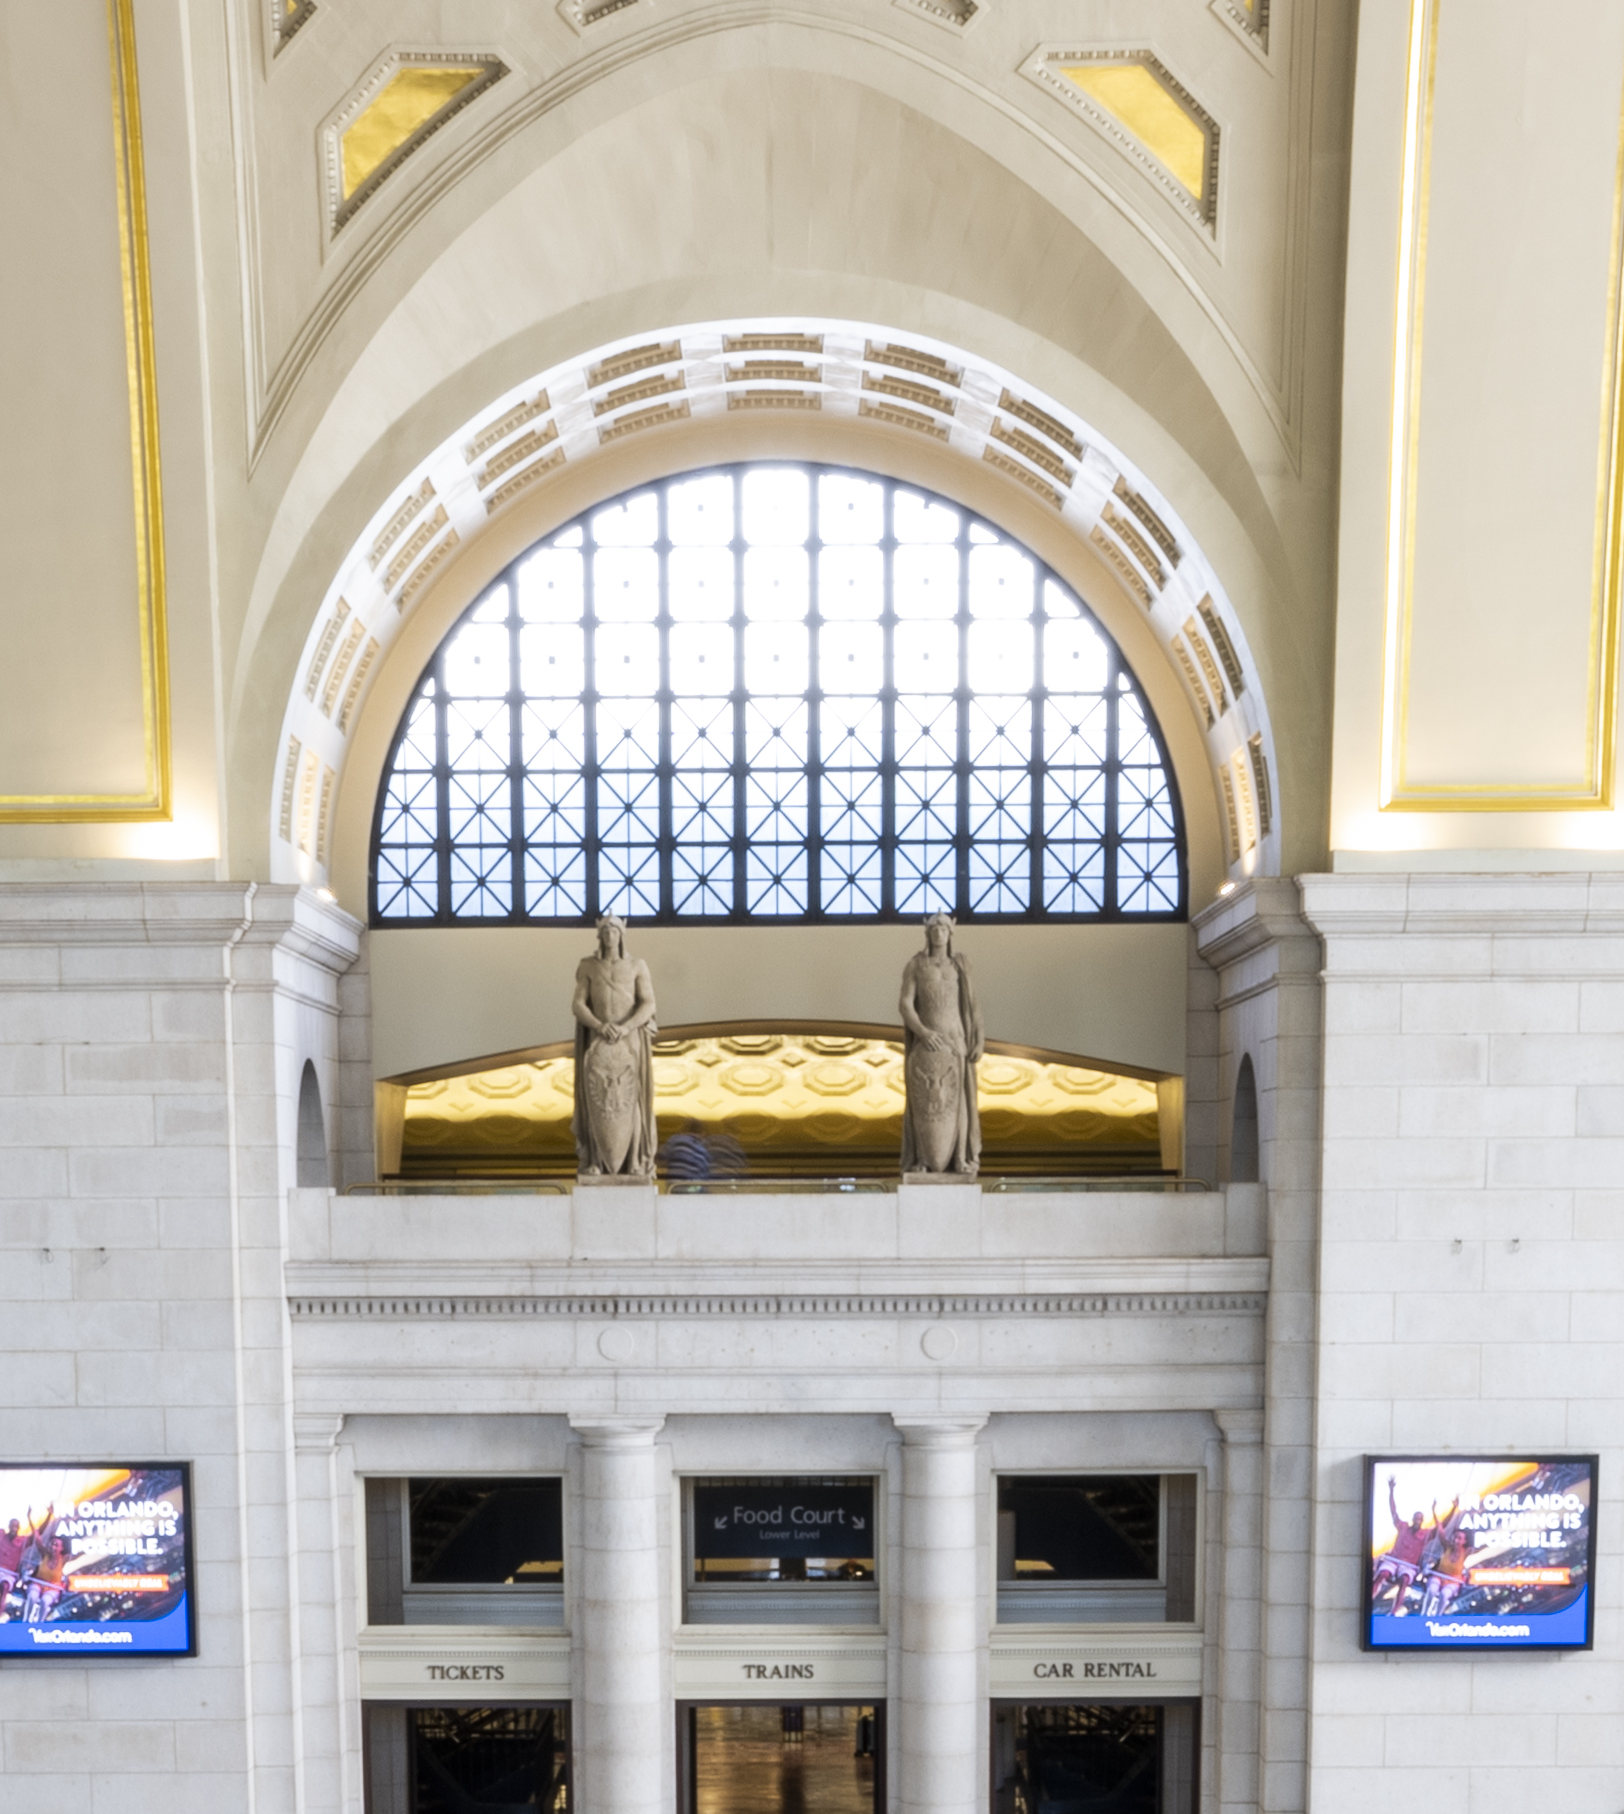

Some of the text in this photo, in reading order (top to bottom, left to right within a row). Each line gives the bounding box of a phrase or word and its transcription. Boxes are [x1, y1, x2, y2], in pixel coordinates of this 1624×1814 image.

[78, 1501, 179, 1519] ORLANDO,
[1483, 1493, 1584, 1513] ORLANDO,
[733, 1504, 847, 1527] Food Court
[1459, 1513, 1581, 1530] ANYTHING IS
[55, 1519, 176, 1537] ANYTHING IS
[759, 1529, 820, 1541] Lower Level
[427, 1664, 505, 1682] TICKETS
[743, 1664, 814, 1680] TRAINS
[1033, 1661, 1157, 1679] CAR RENTAL
